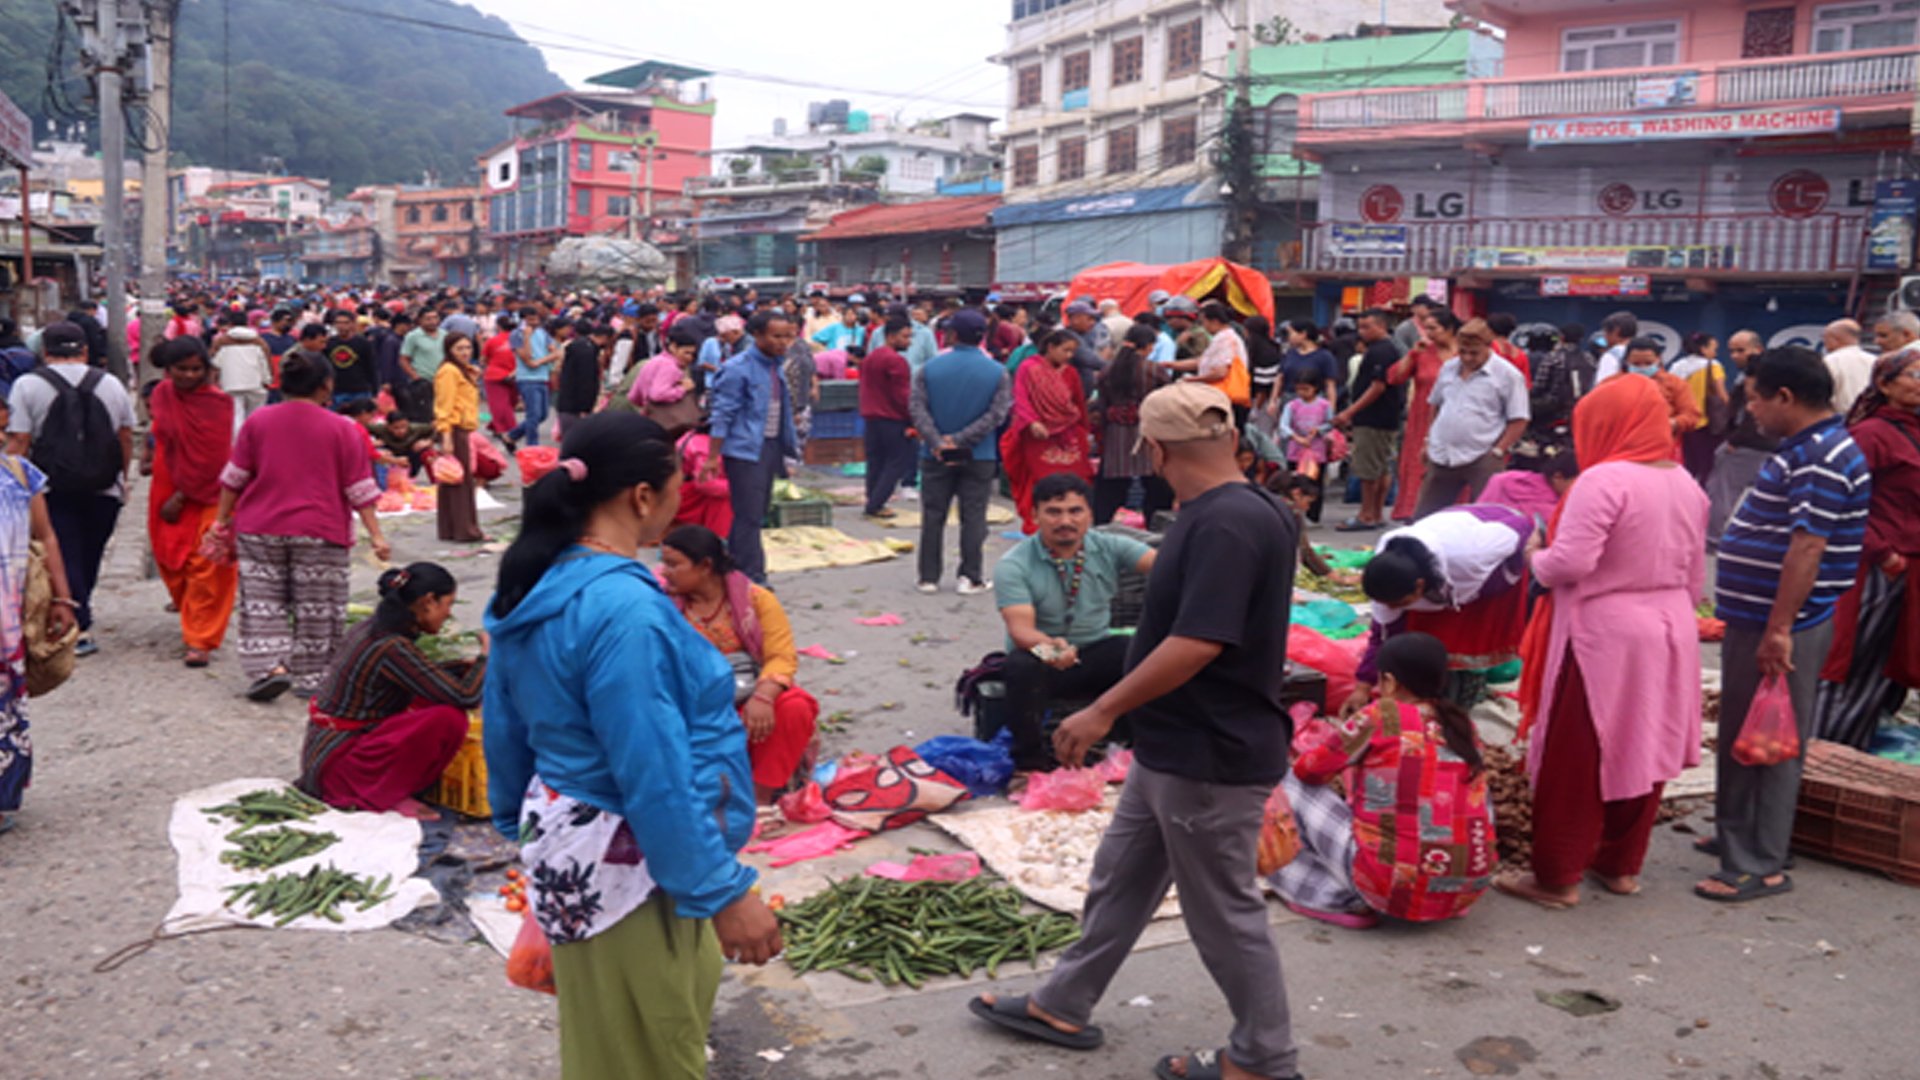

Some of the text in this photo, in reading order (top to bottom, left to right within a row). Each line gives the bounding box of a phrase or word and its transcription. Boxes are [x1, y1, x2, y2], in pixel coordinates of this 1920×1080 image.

[1642, 114, 1733, 134] WASHING
[1738, 109, 1836, 130] MACHINE
[1415, 192, 1464, 218] LG
[1643, 189, 1683, 211] LG
[1848, 179, 1875, 206] L
